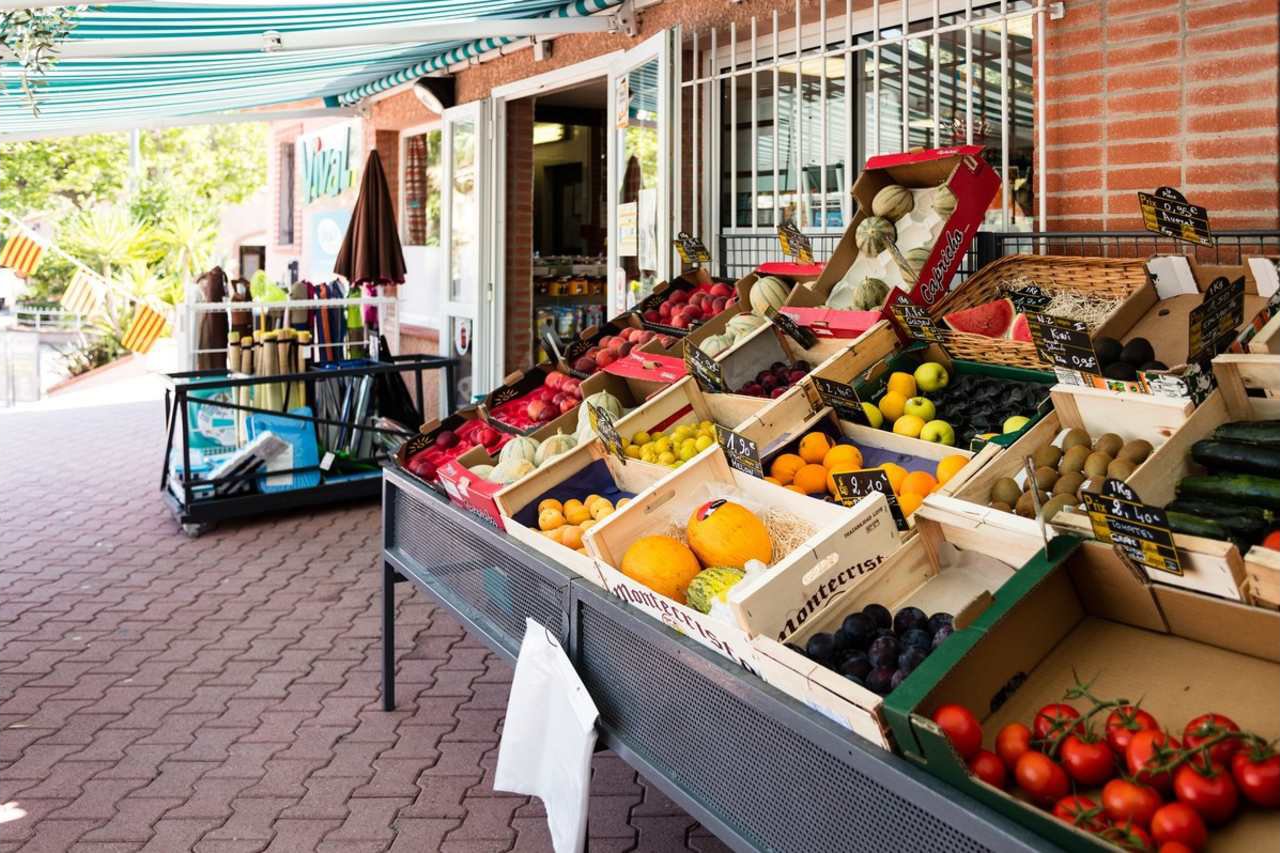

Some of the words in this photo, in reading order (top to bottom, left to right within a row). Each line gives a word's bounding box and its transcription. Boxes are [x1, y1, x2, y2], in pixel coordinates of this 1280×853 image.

[303, 127, 352, 205] Vival
[921, 229, 963, 304] Capricho
[1084, 494, 1108, 513] Prix
[1110, 480, 1133, 500] 1Kg
